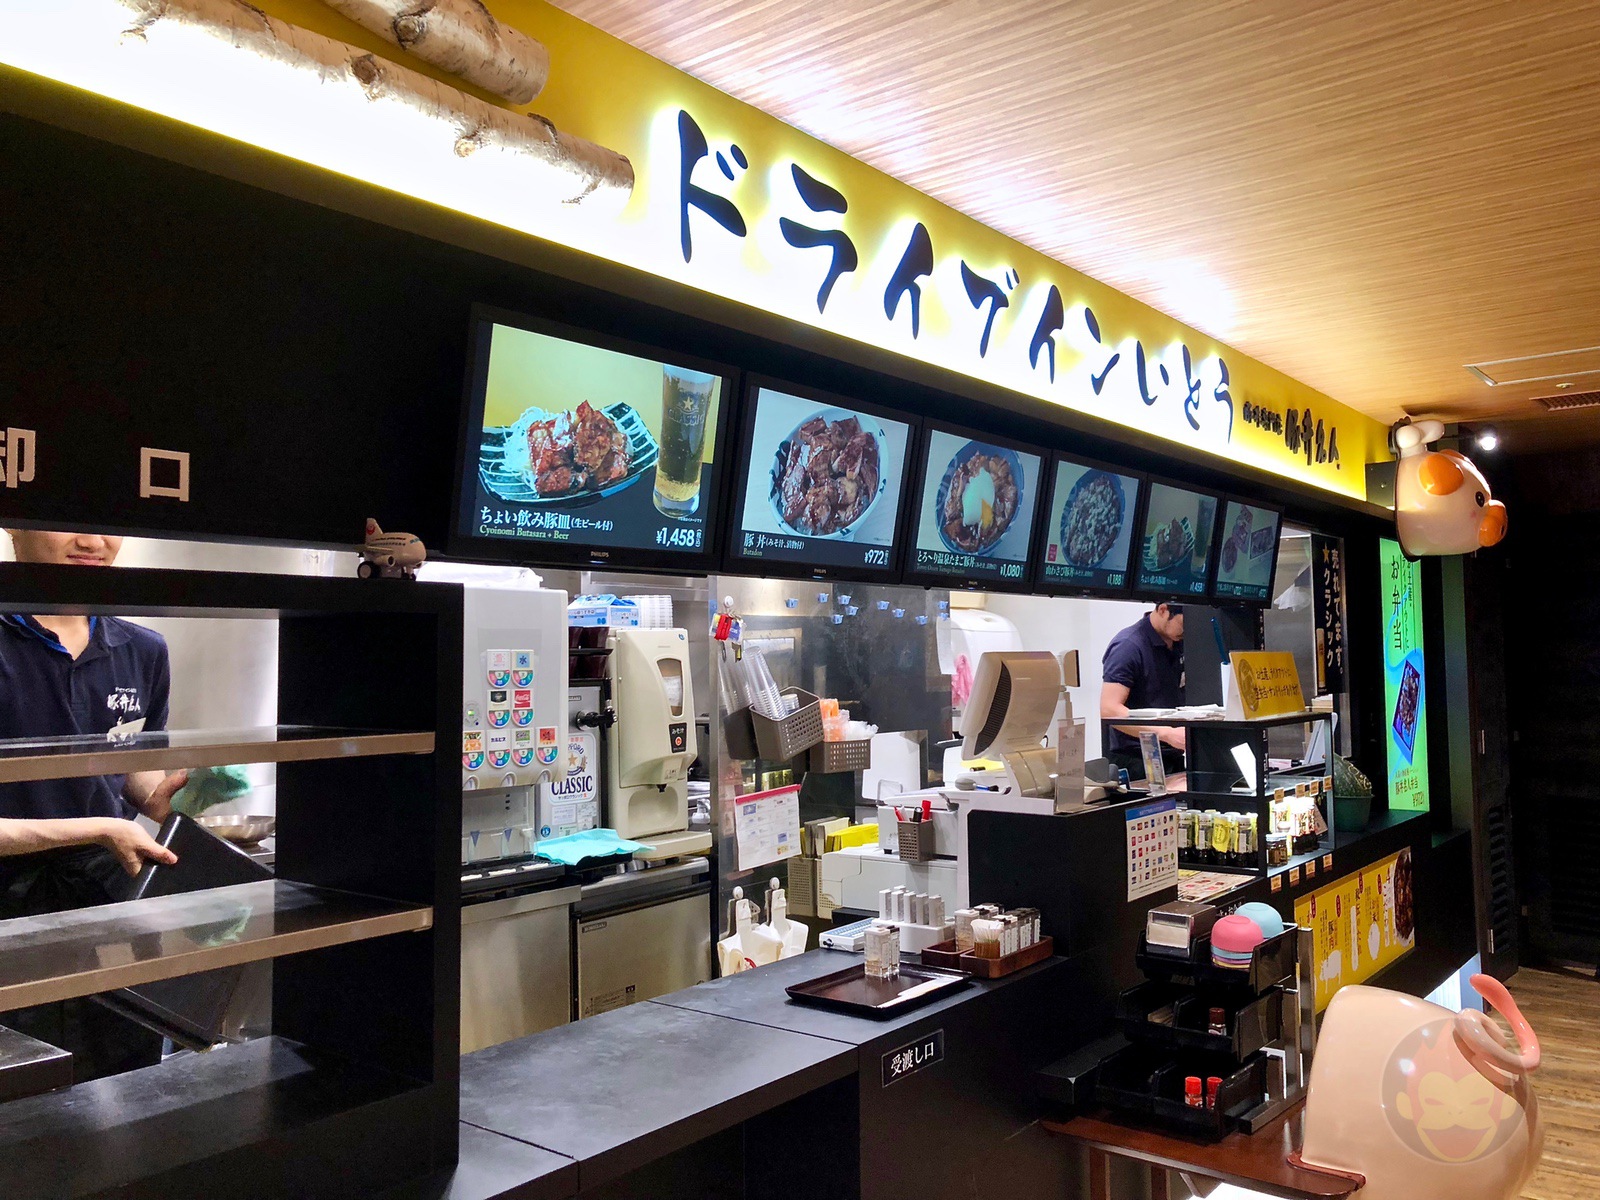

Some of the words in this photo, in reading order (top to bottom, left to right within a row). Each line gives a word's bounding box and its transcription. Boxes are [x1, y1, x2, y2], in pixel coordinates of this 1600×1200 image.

[678, 109, 1234, 444] ドライブインいとう
[554, 530, 570, 540] Beer
[656, 527, 695, 547] ¥1,458
[864, 549, 884, 565] ¥972
[1391, 555, 1401, 650] お弁当
[551, 775, 593, 796] CLASSIC
[891, 1042, 934, 1077] 受渡し口
